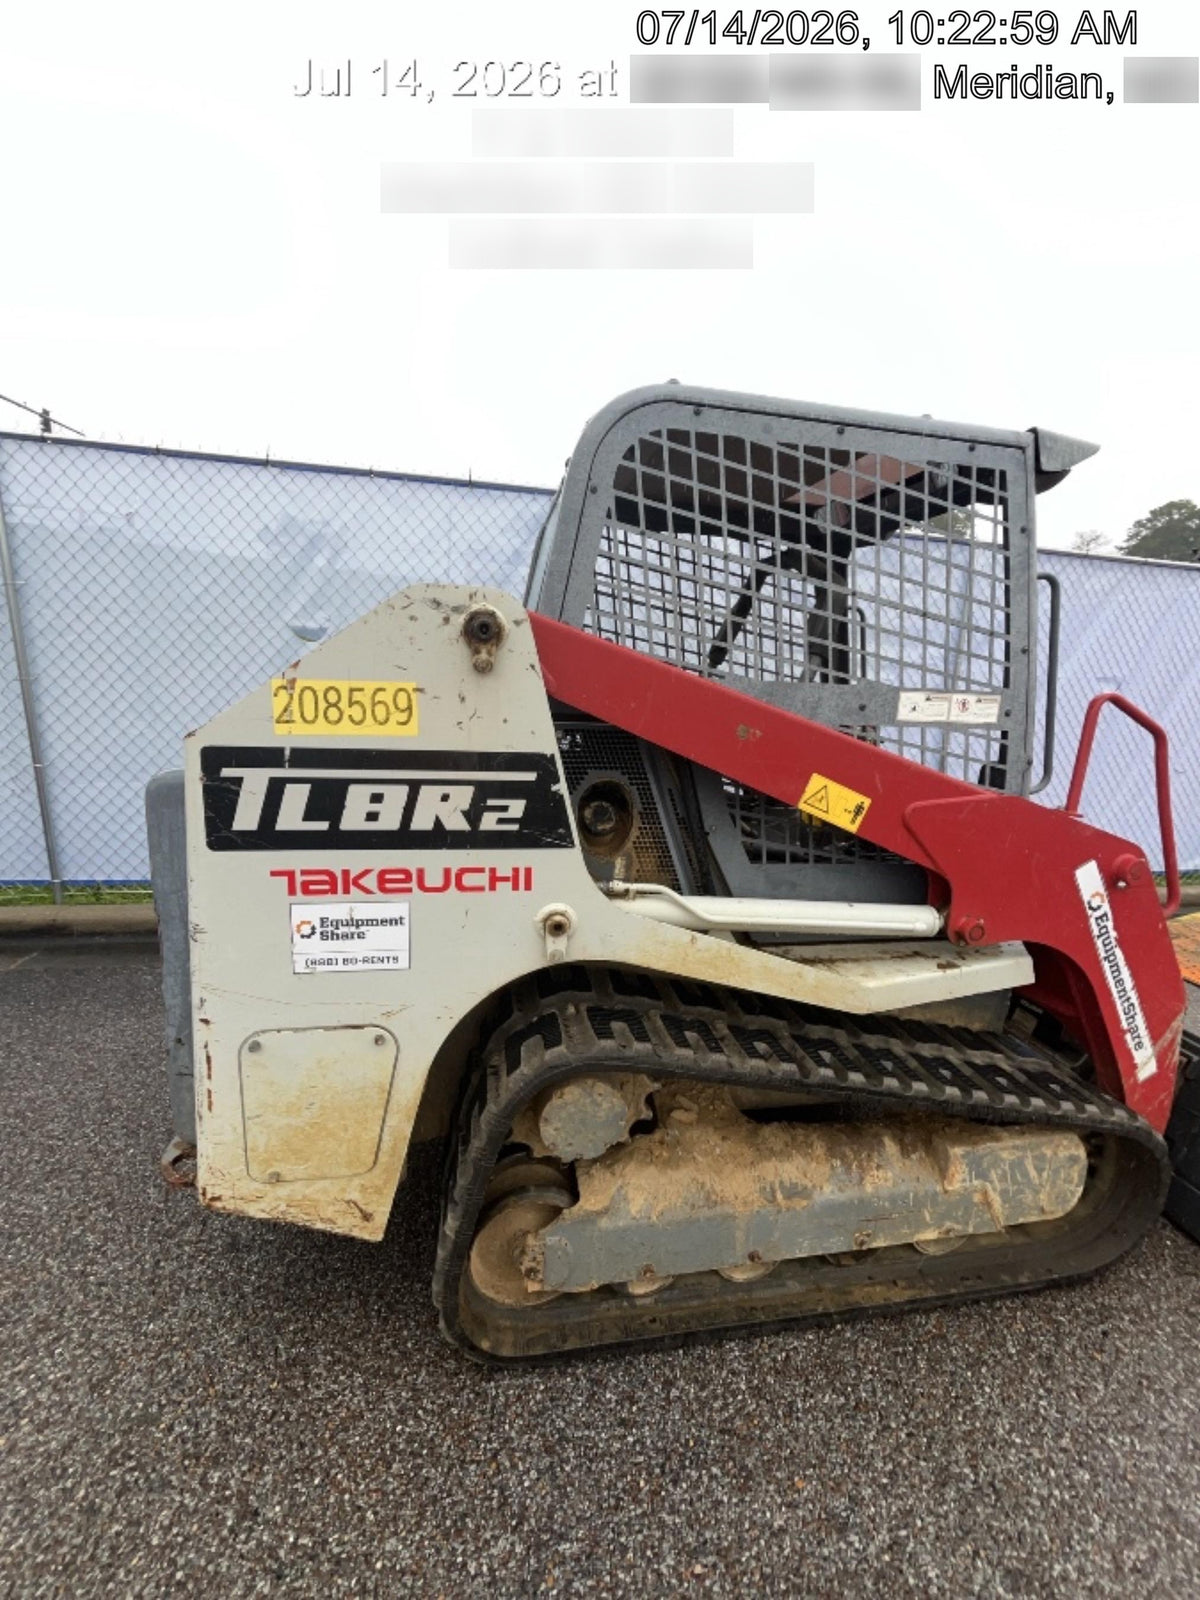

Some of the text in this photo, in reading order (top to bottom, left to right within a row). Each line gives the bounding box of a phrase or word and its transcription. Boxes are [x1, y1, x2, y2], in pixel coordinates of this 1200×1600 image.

[273, 685, 414, 726] 208569
[220, 767, 538, 831] TL8R2
[269, 866, 534, 897] TAKEUCHI
[319, 916, 406, 931] Equipment
[319, 929, 366, 941] Share
[1093, 911, 1145, 1052] EquipmentShare
